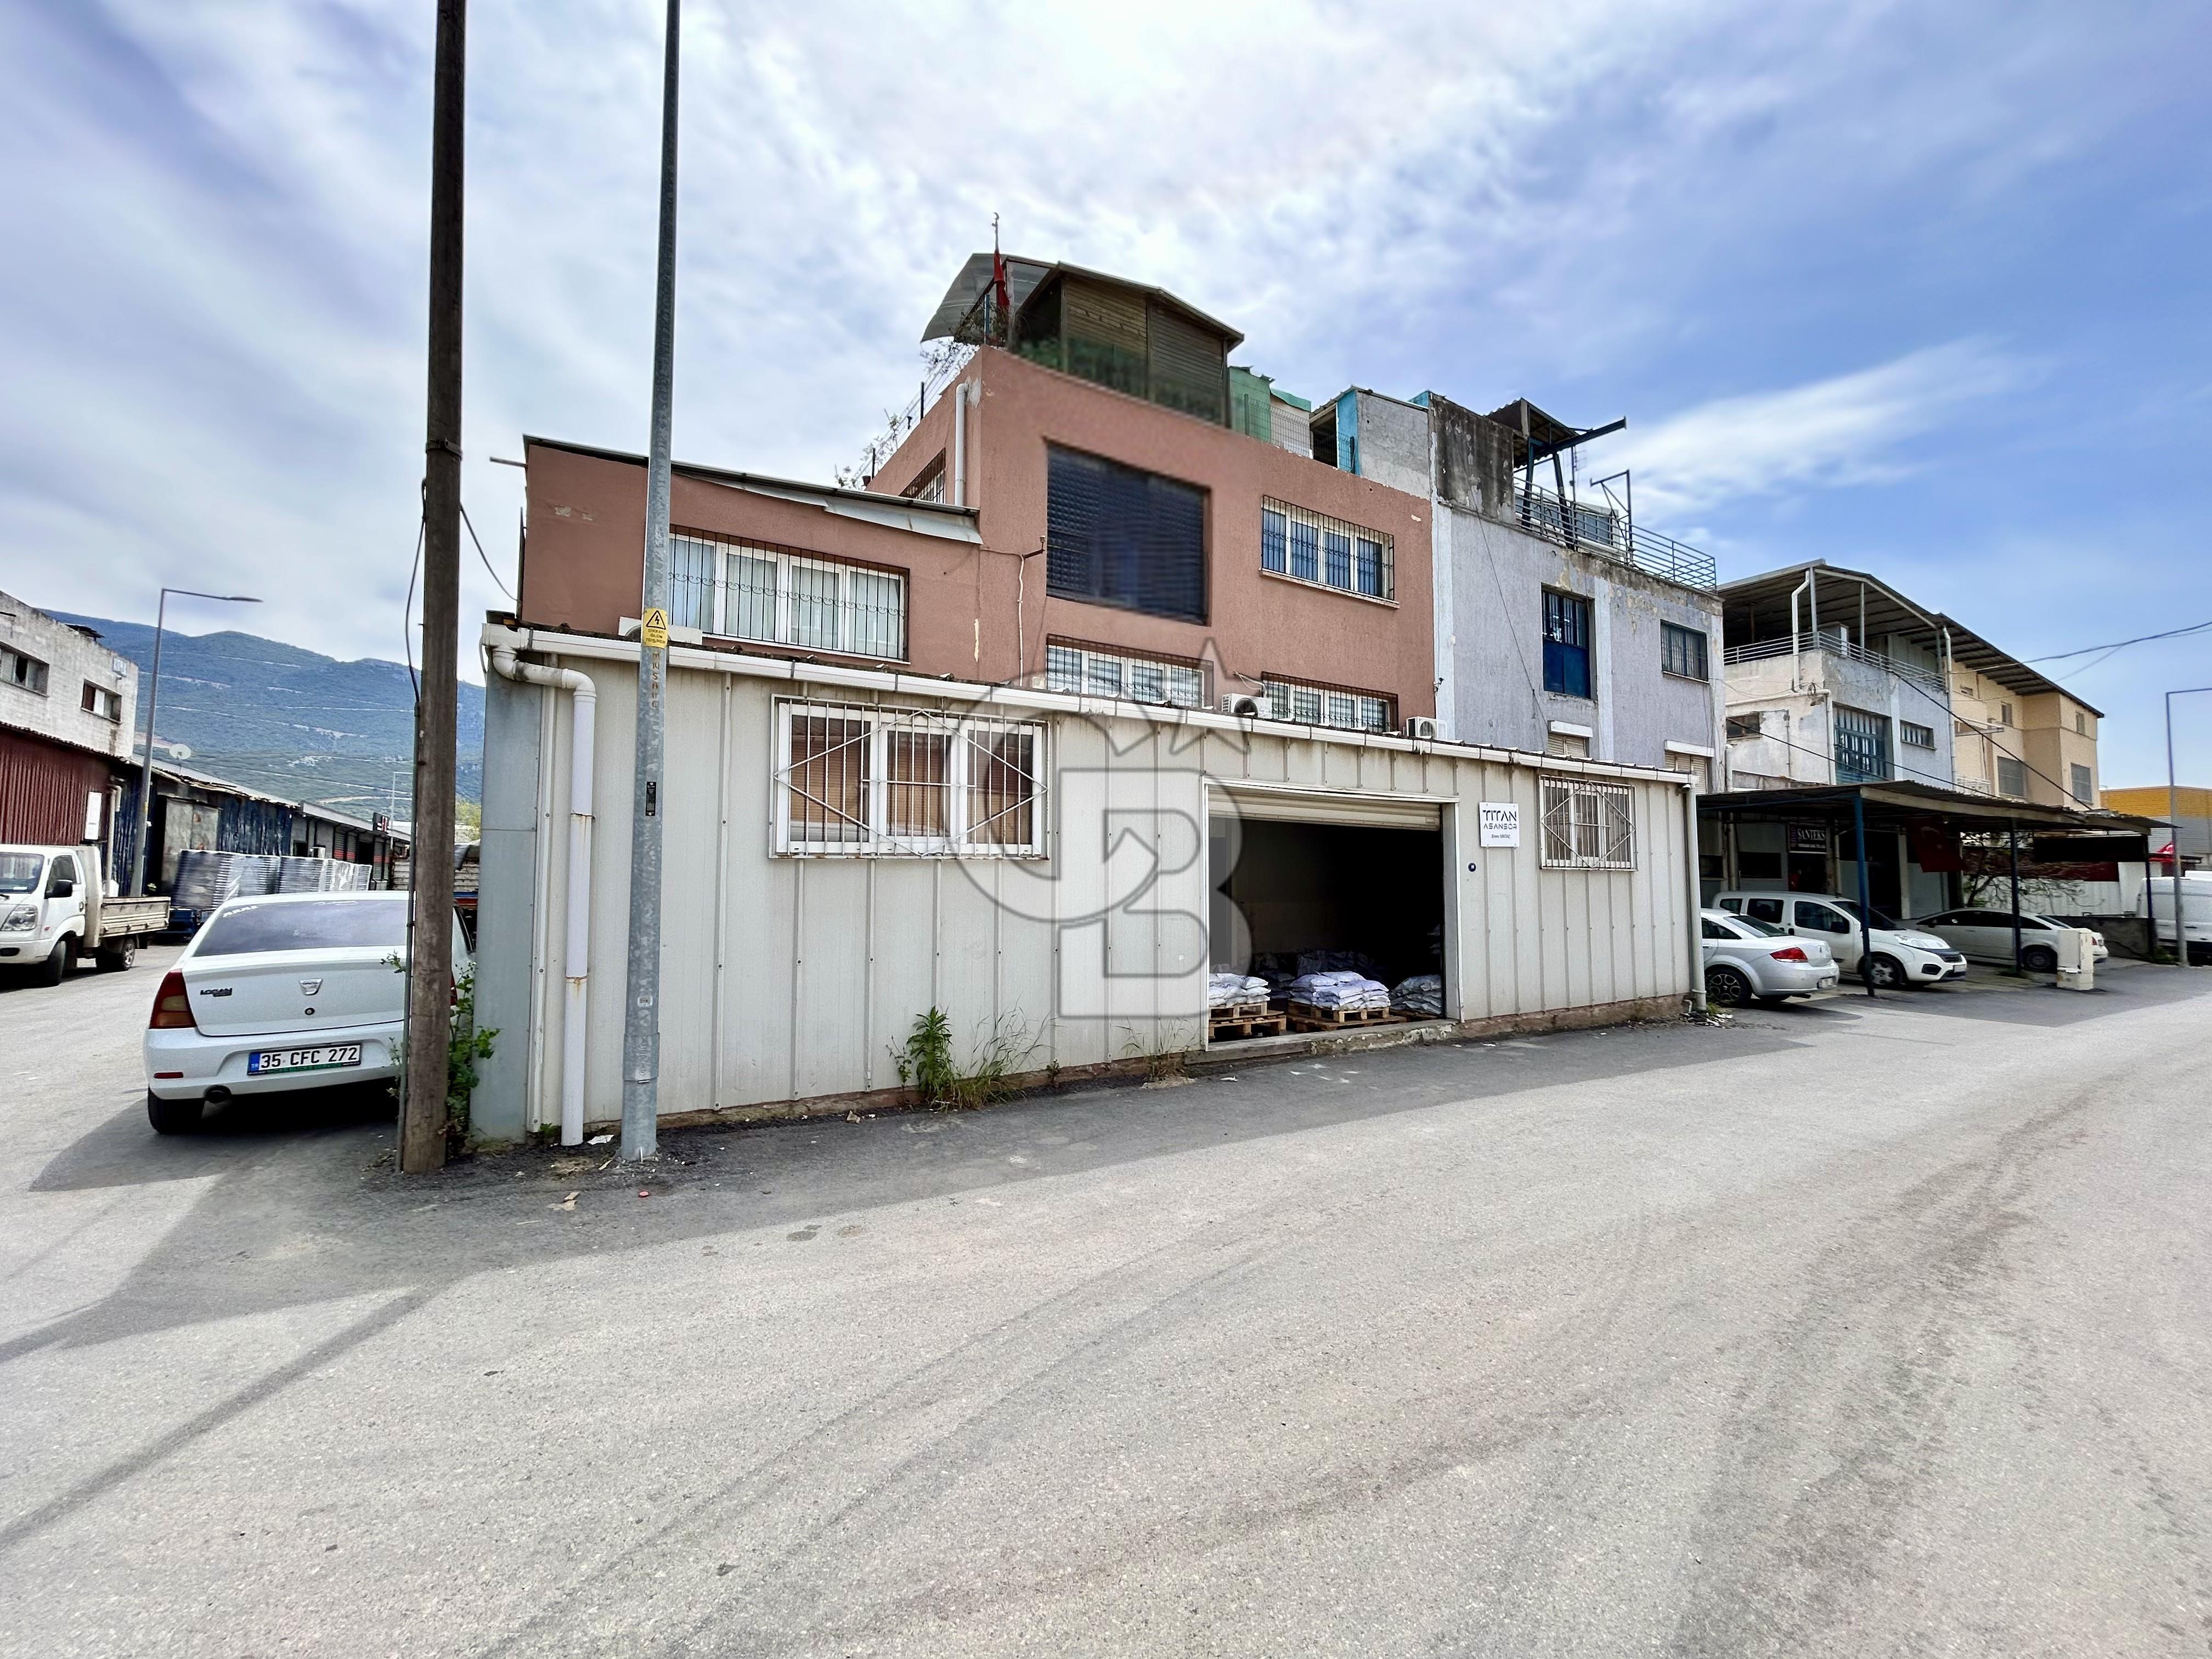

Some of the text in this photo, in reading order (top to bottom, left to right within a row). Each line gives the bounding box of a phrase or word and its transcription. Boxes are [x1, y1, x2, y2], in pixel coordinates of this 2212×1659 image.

[1482, 810, 1517, 821] TITAN
[200, 988, 233, 996] LOGAN
[261, 1053, 281, 1069] 35
[290, 1050, 320, 1065] CFC
[328, 1047, 357, 1062] 272
